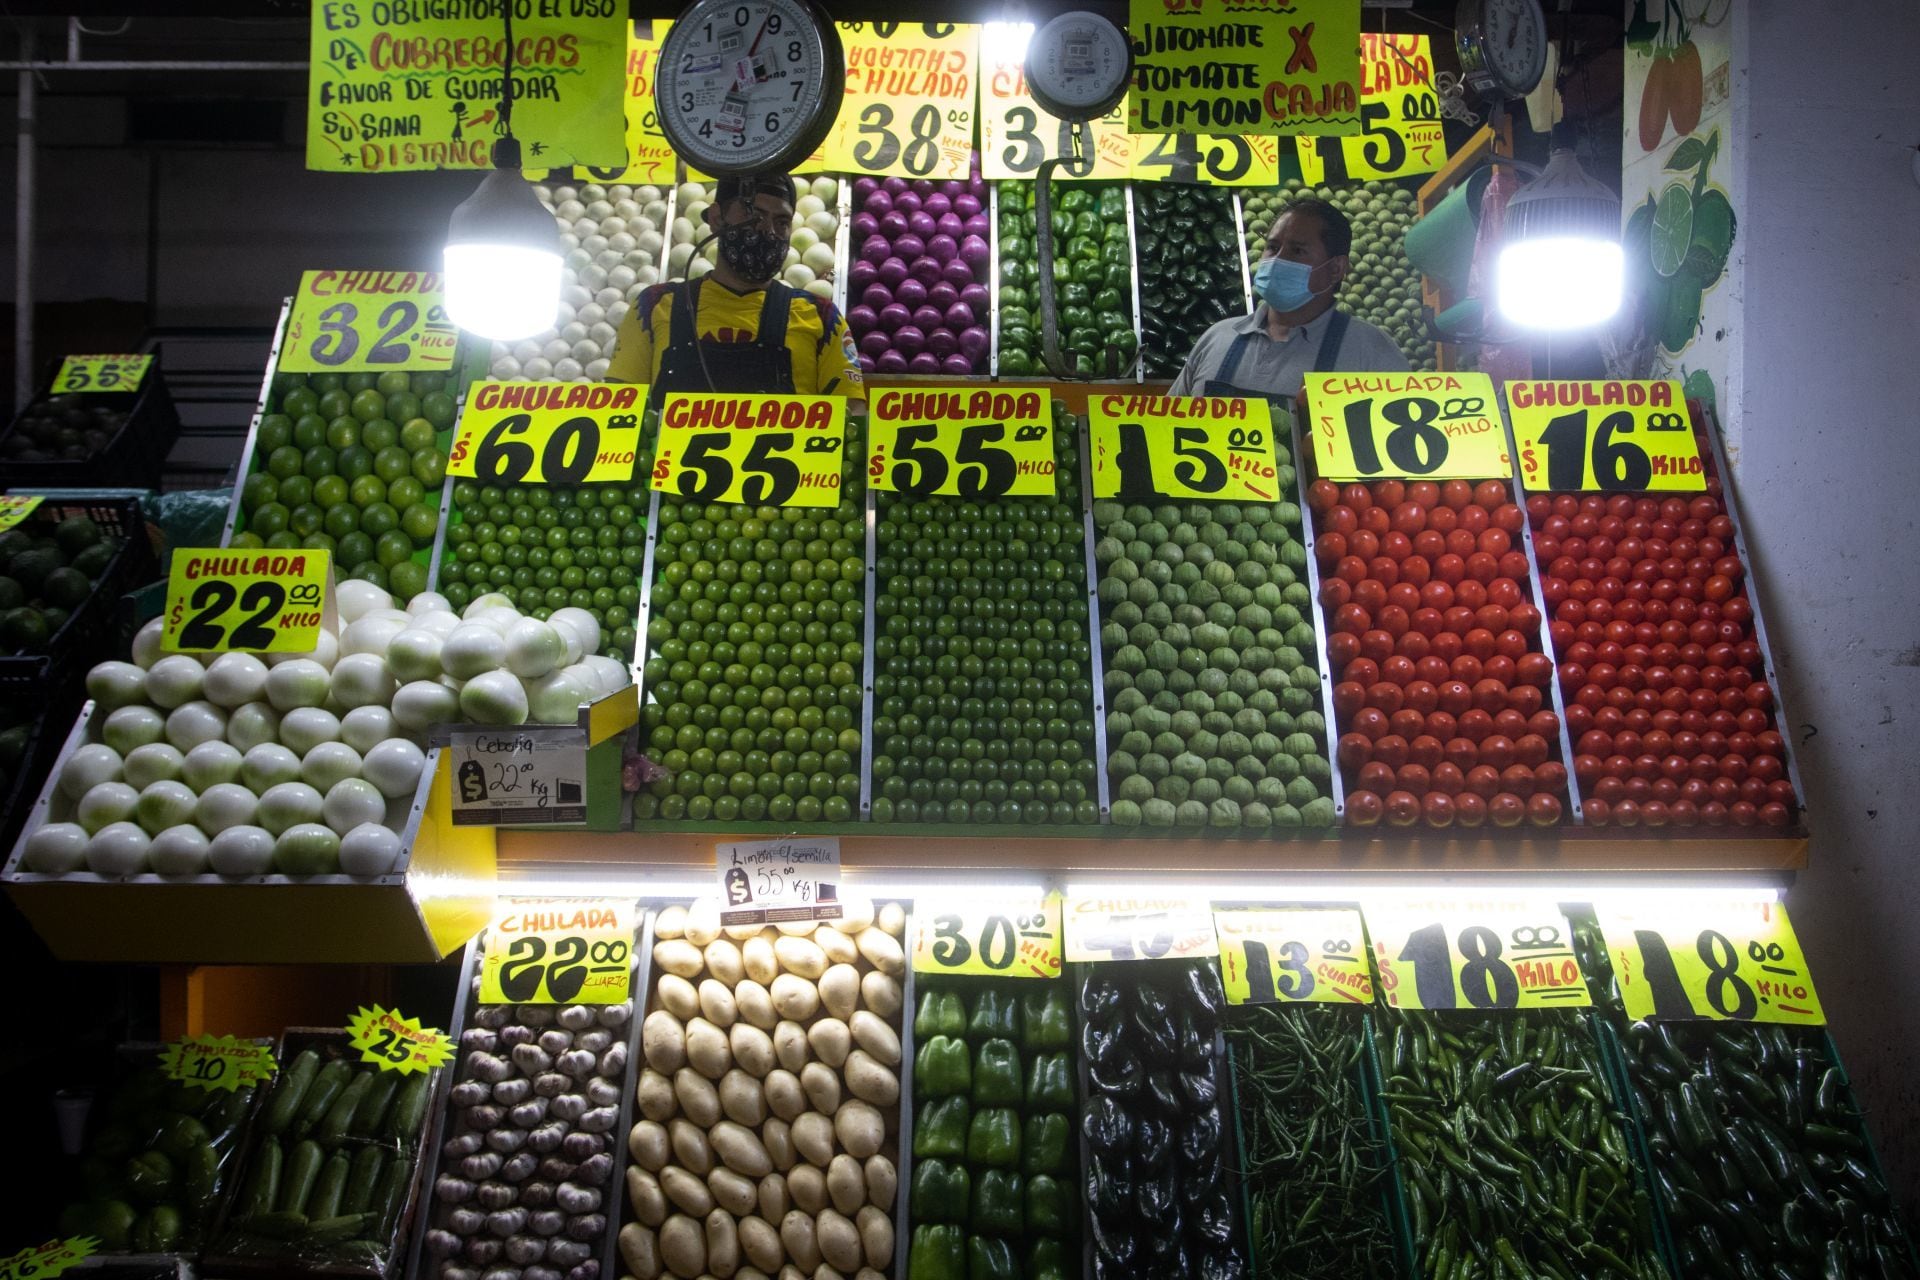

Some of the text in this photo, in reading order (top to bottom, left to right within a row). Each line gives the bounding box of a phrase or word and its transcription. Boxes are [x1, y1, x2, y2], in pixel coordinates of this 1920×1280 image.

[323, 2, 360, 31] ES
[538, 0, 562, 18] EL
[571, 0, 616, 18] USO
[735, 7, 750, 27] 0
[767, 15, 782, 35] 9
[703, 23, 713, 43] 1
[1134, 23, 1264, 56] JITOMATE
[1285, 22, 1317, 74] X
[330, 32, 580, 72] DE CUBREBOCAS
[682, 54, 695, 74] 2
[788, 41, 801, 62] 8
[320, 76, 560, 107] FAVOR DE GUARDAR
[790, 81, 804, 102] 7
[844, 68, 969, 100] CHULADA
[1132, 62, 1260, 92] TOMATE
[681, 92, 695, 112] 3
[1141, 97, 1262, 129] LIMON
[1263, 81, 1357, 120] CAJA
[1403, 93, 1436, 119] 00
[322, 112, 421, 141] SU SANA
[698, 119, 713, 139] 4
[765, 112, 780, 132] 6
[853, 103, 942, 176] 38
[947, 109, 969, 123] 00
[310, 301, 418, 366] 32
[65, 364, 121, 390] 55
[1322, 375, 1462, 395] CHULADA
[475, 384, 638, 411] CHULADA
[876, 391, 1041, 421] CHULADA
[1101, 395, 1247, 420] CHULADA
[1512, 382, 1672, 408] CHULADA
[665, 399, 832, 429] CHULADA
[1444, 418, 1491, 437] KILO
[474, 414, 600, 483] 60
[1343, 397, 1449, 475] 18
[1443, 397, 1484, 417] 00
[1537, 409, 1651, 490] 16
[596, 451, 635, 465] KILO
[677, 432, 800, 506] 55
[891, 423, 1017, 496] 55
[1113, 424, 1228, 499] 15
[1228, 428, 1263, 446] 00
[1229, 452, 1275, 479] KILO
[1651, 455, 1702, 475] KILO
[799, 473, 840, 488] KILO
[186, 555, 306, 580] CHULADA
[178, 580, 286, 649] 22
[290, 584, 320, 600] 00
[279, 612, 320, 629] KILO
[464, 773, 483, 799] $
[489, 762, 522, 792] 22
[730, 879, 748, 902] $
[758, 867, 783, 895] 55
[500, 909, 617, 932] CHULADA
[932, 913, 1046, 970] 30 00
[1021, 940, 1061, 969] KILO
[499, 936, 588, 1002] 22
[591, 940, 627, 963] 00
[1243, 940, 1315, 1003] 13
[1322, 939, 1351, 953] 00
[1317, 963, 1372, 995] CUARTO
[1397, 923, 1519, 1009] 18
[1511, 926, 1560, 946] 00
[1516, 960, 1578, 988] KILO
[1633, 930, 1758, 1020] 18
[1748, 940, 1784, 962] 00
[1757, 979, 1807, 1000] KILO
[368, 1029, 417, 1062] 25
[186, 1057, 226, 1081] 10
